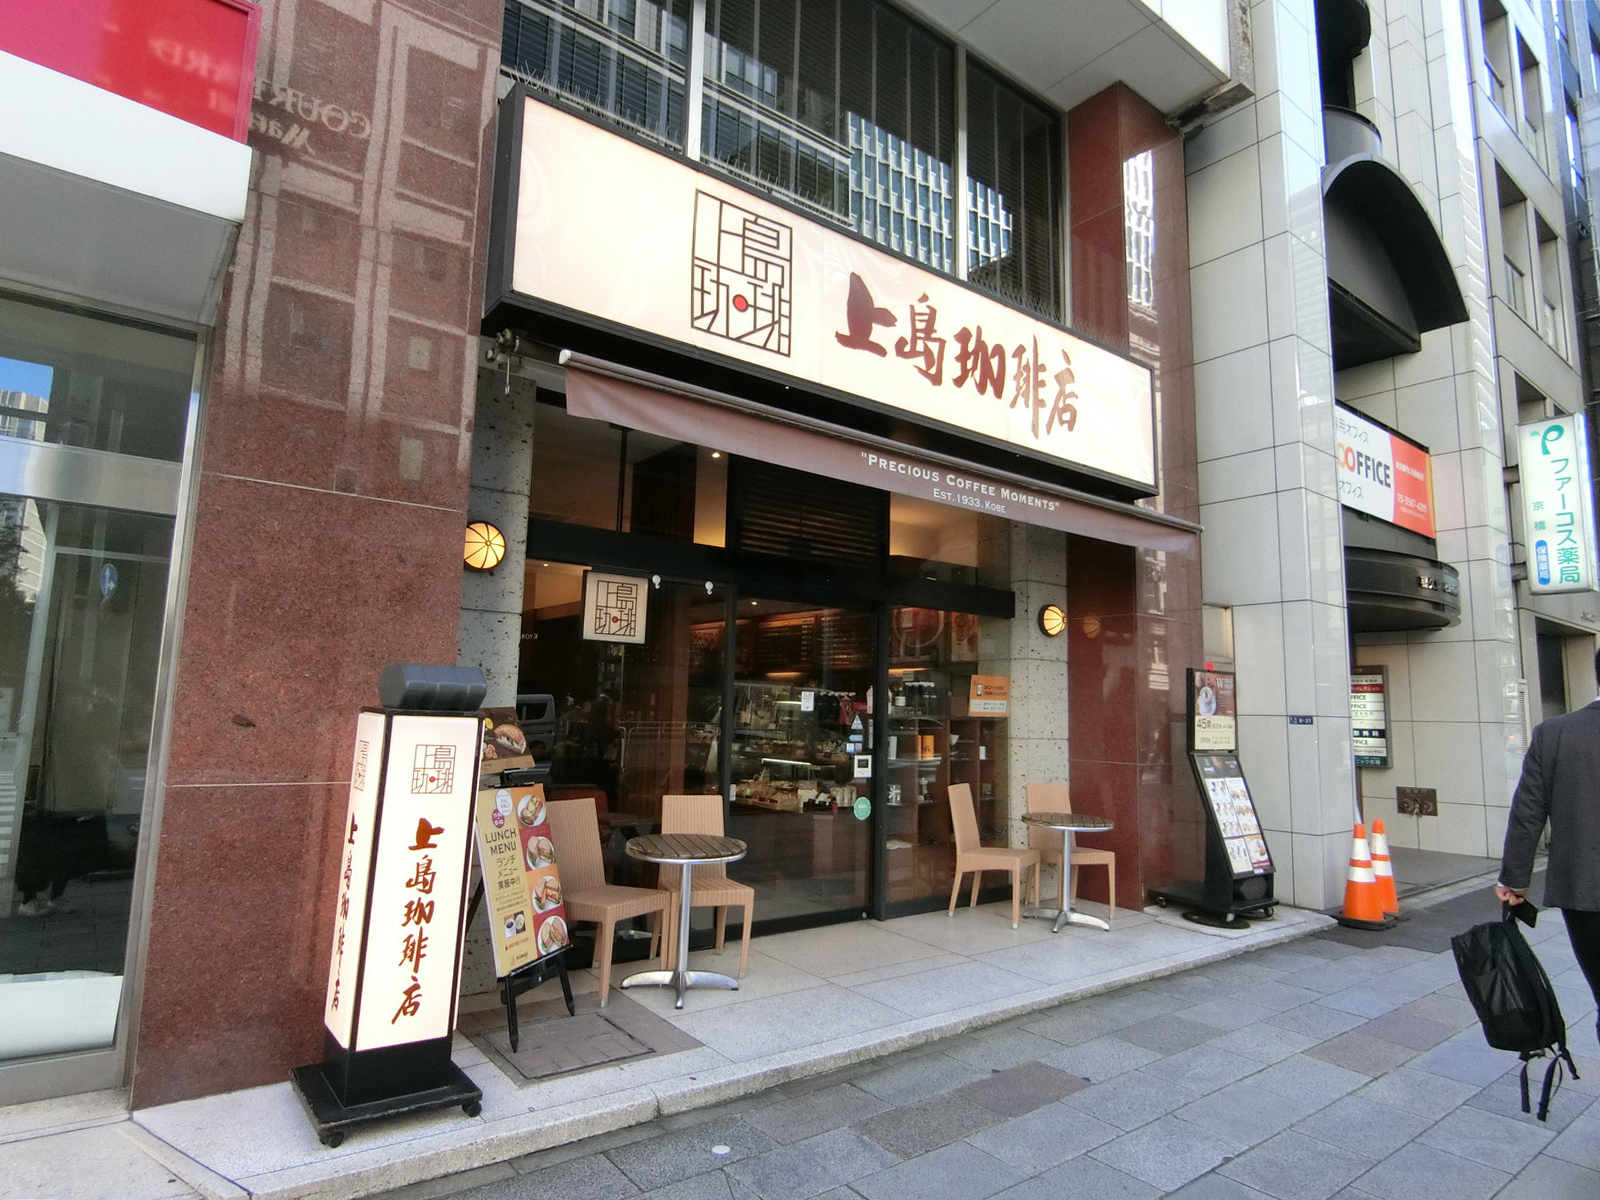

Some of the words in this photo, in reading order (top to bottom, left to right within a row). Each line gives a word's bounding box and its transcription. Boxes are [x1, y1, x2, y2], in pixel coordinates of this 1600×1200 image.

[835, 271, 1078, 440] 上島珈琲店
[946, 474, 995, 496] COFFEE
[1550, 457, 1581, 584] ファーコス薬局
[485, 828, 517, 843] LUNCH
[490, 841, 517, 856] MENU
[496, 855, 517, 868] ランチ
[497, 867, 518, 879] メニュー
[392, 817, 446, 1025] 上島珈琲店
